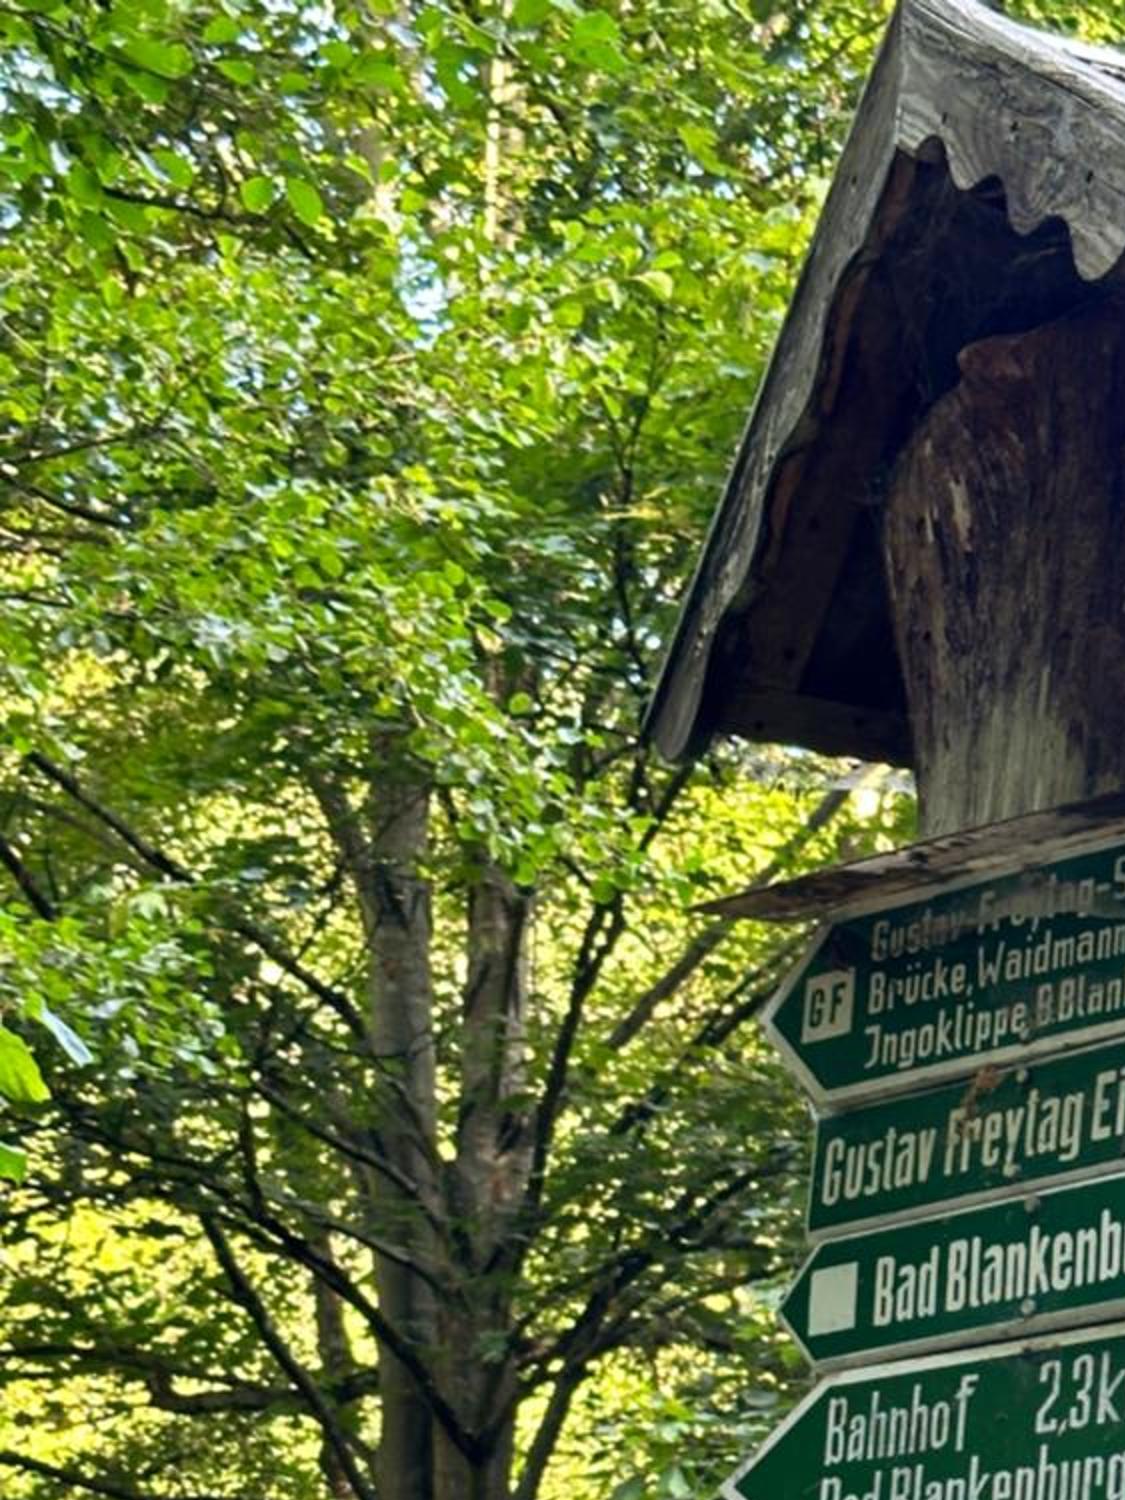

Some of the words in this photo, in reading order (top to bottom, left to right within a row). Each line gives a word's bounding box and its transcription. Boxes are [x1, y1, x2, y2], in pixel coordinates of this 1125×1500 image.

[809, 981, 847, 1028] GF
[867, 957, 974, 1016] Brücke,
[821, 1126, 937, 1207] Gustav
[943, 1089, 1085, 1178] Freytag
[872, 1244, 941, 1328] Bad
[823, 1373, 980, 1467] Bahnhof
